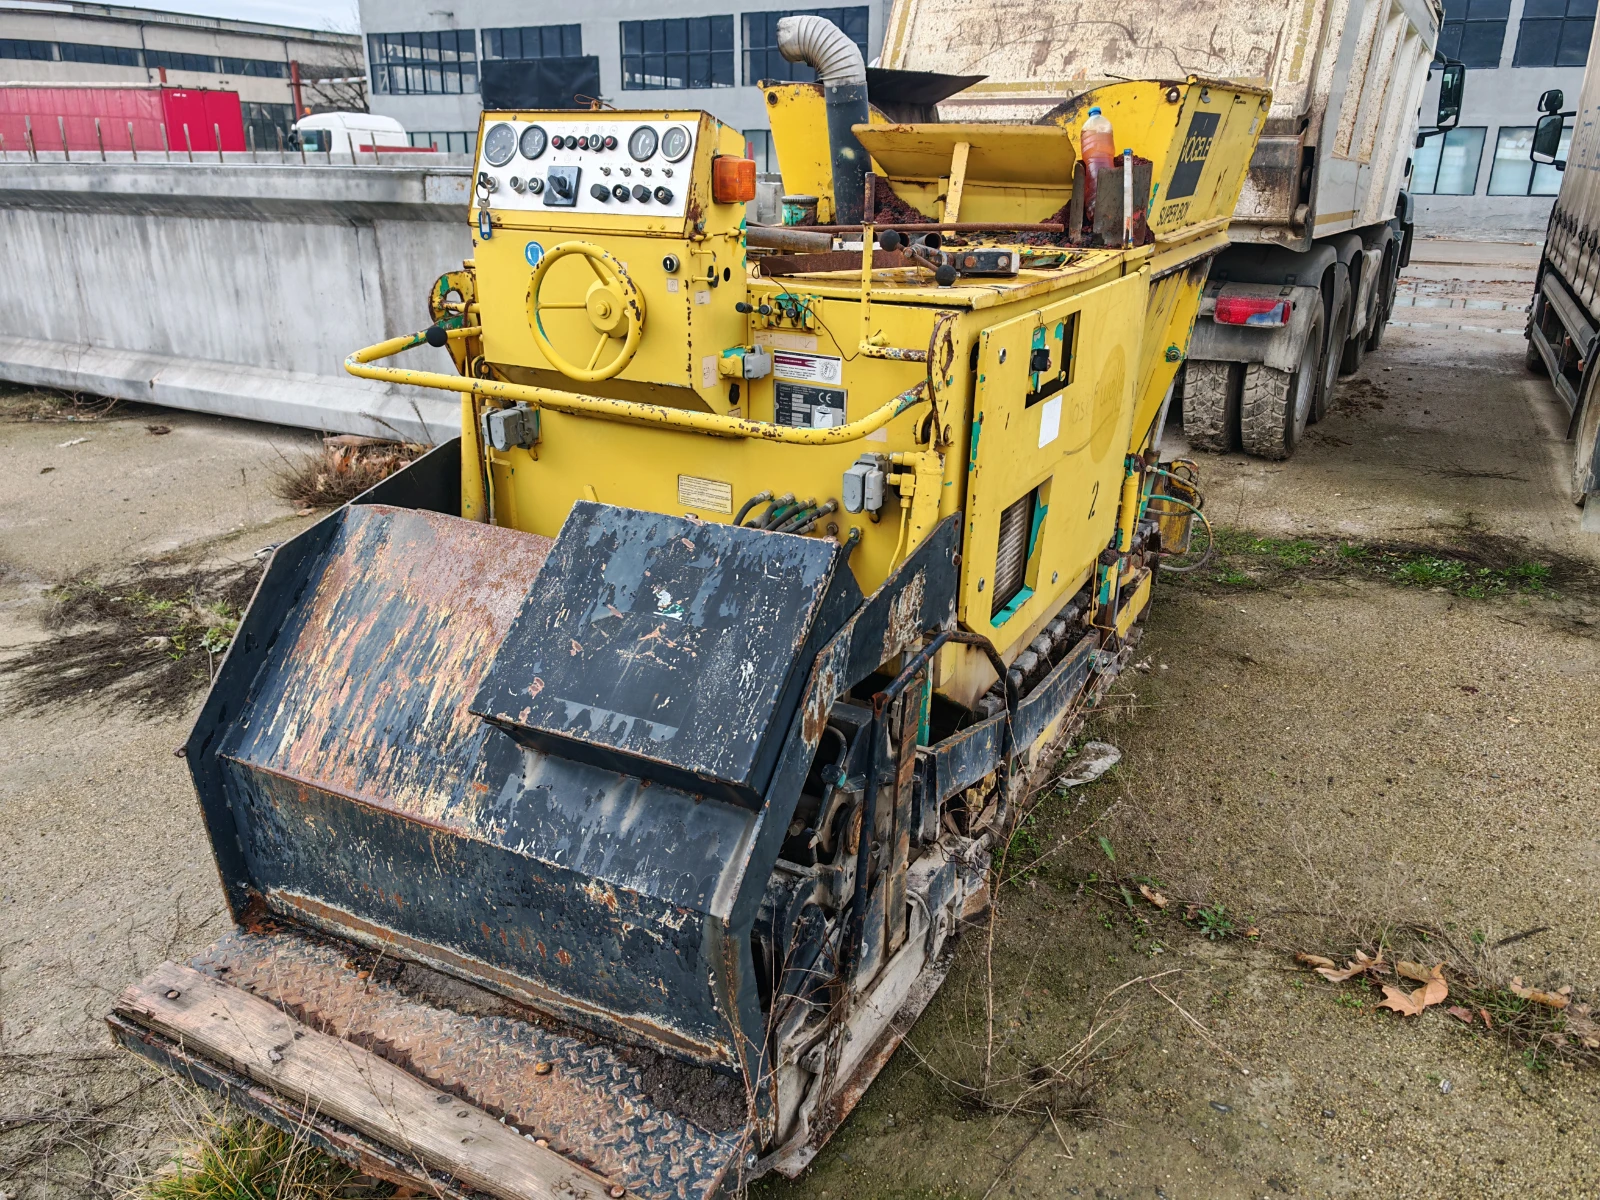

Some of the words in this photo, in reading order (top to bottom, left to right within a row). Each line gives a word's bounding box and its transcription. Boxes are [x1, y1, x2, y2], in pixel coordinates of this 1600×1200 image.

[1156, 203, 1180, 227] SUPER
[1175, 200, 1192, 222] BOY
[818, 392, 832, 404] CE
